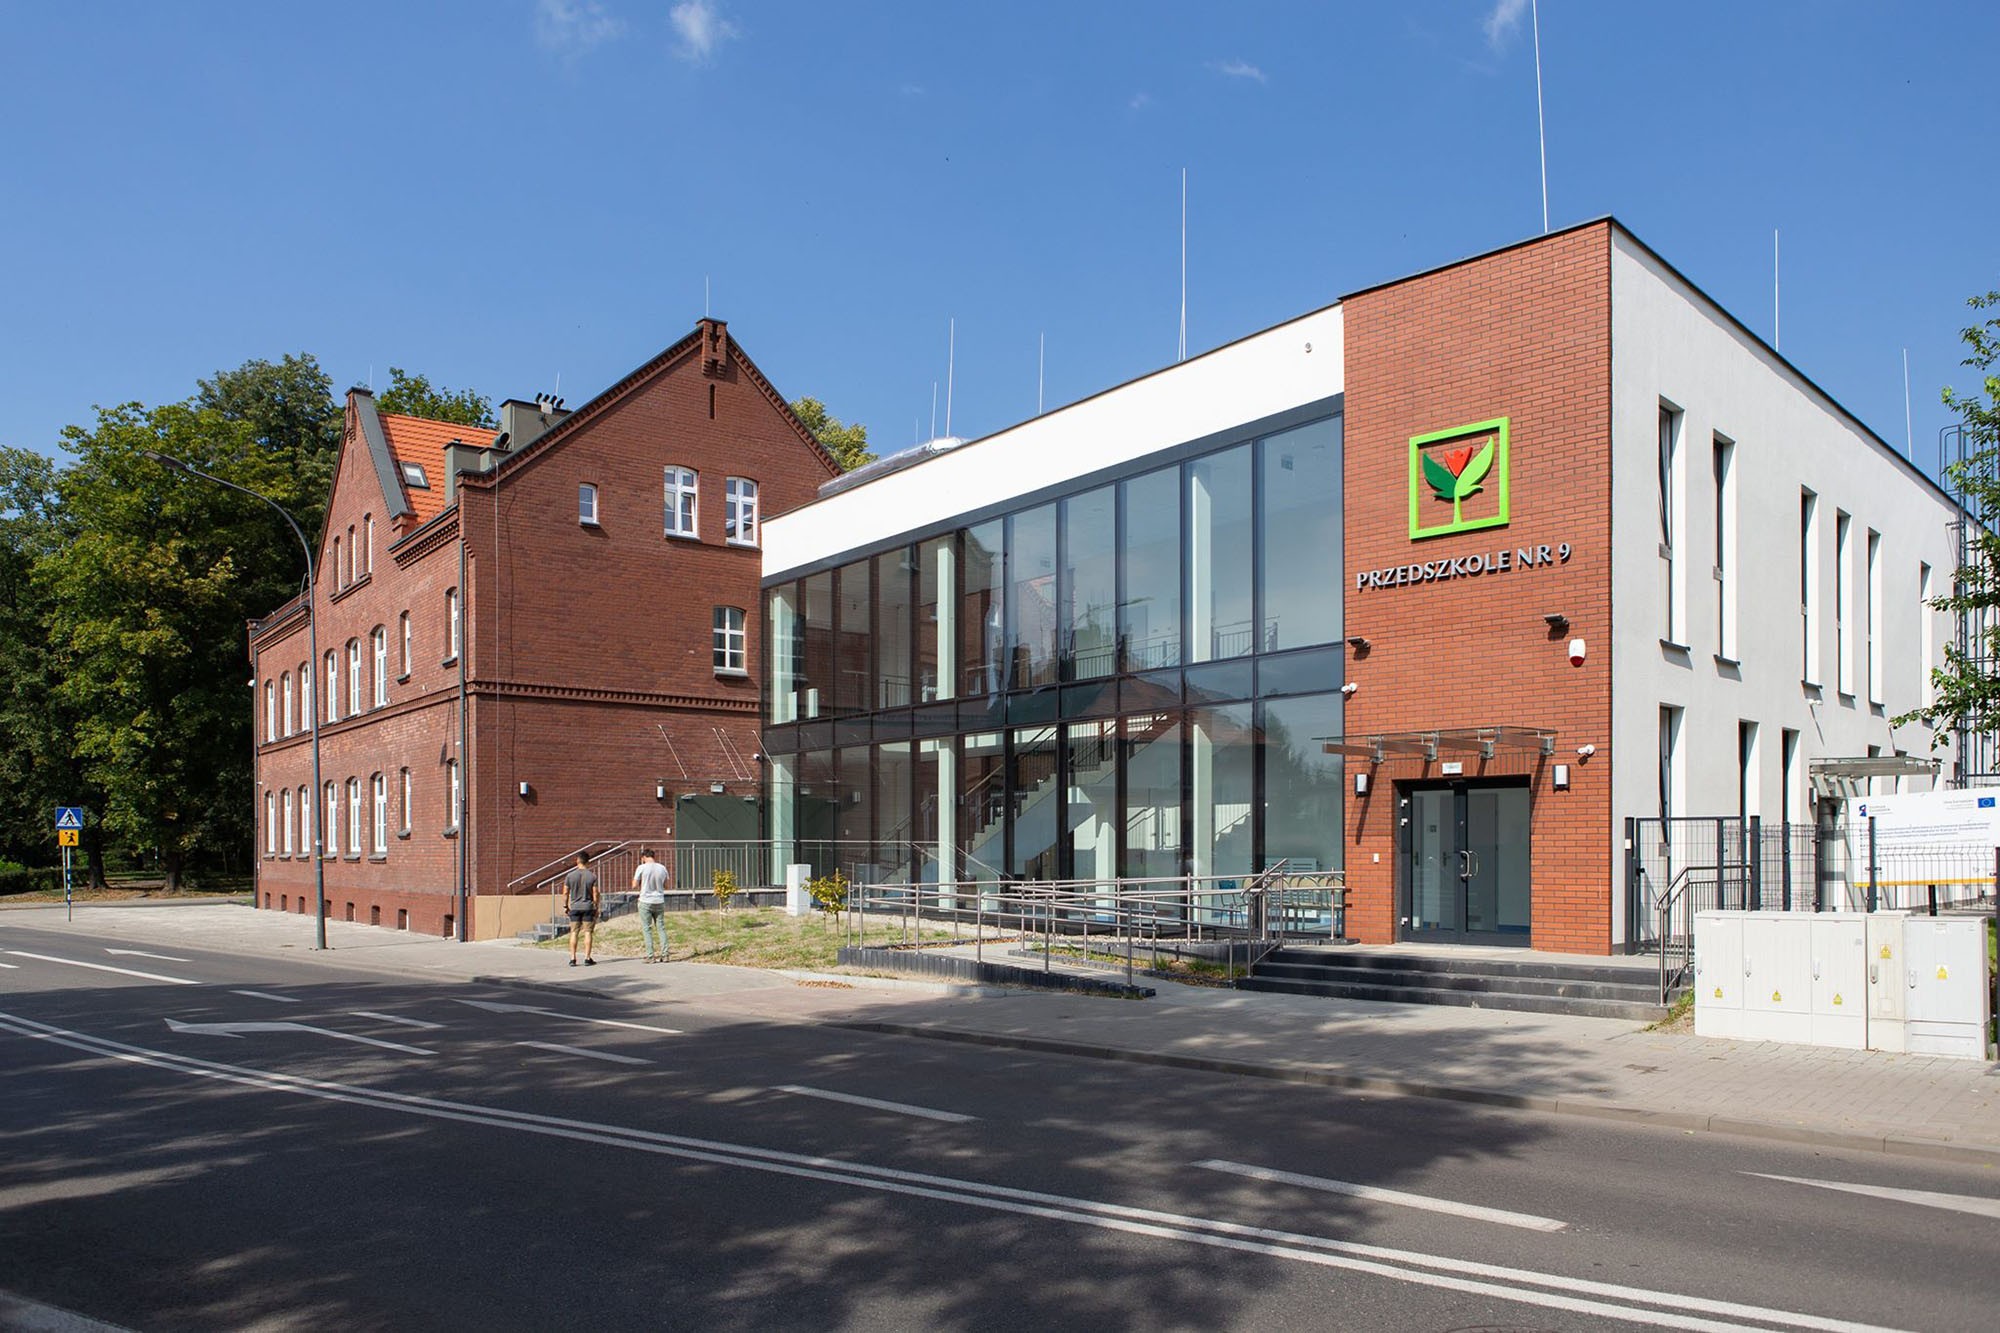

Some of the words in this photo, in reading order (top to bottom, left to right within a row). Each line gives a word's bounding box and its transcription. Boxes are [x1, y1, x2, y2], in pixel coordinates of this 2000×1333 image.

[1356, 551, 1511, 589] PRZEDSZKOLE
[1517, 545, 1552, 566] NR
[1558, 542, 1571, 561] 9
